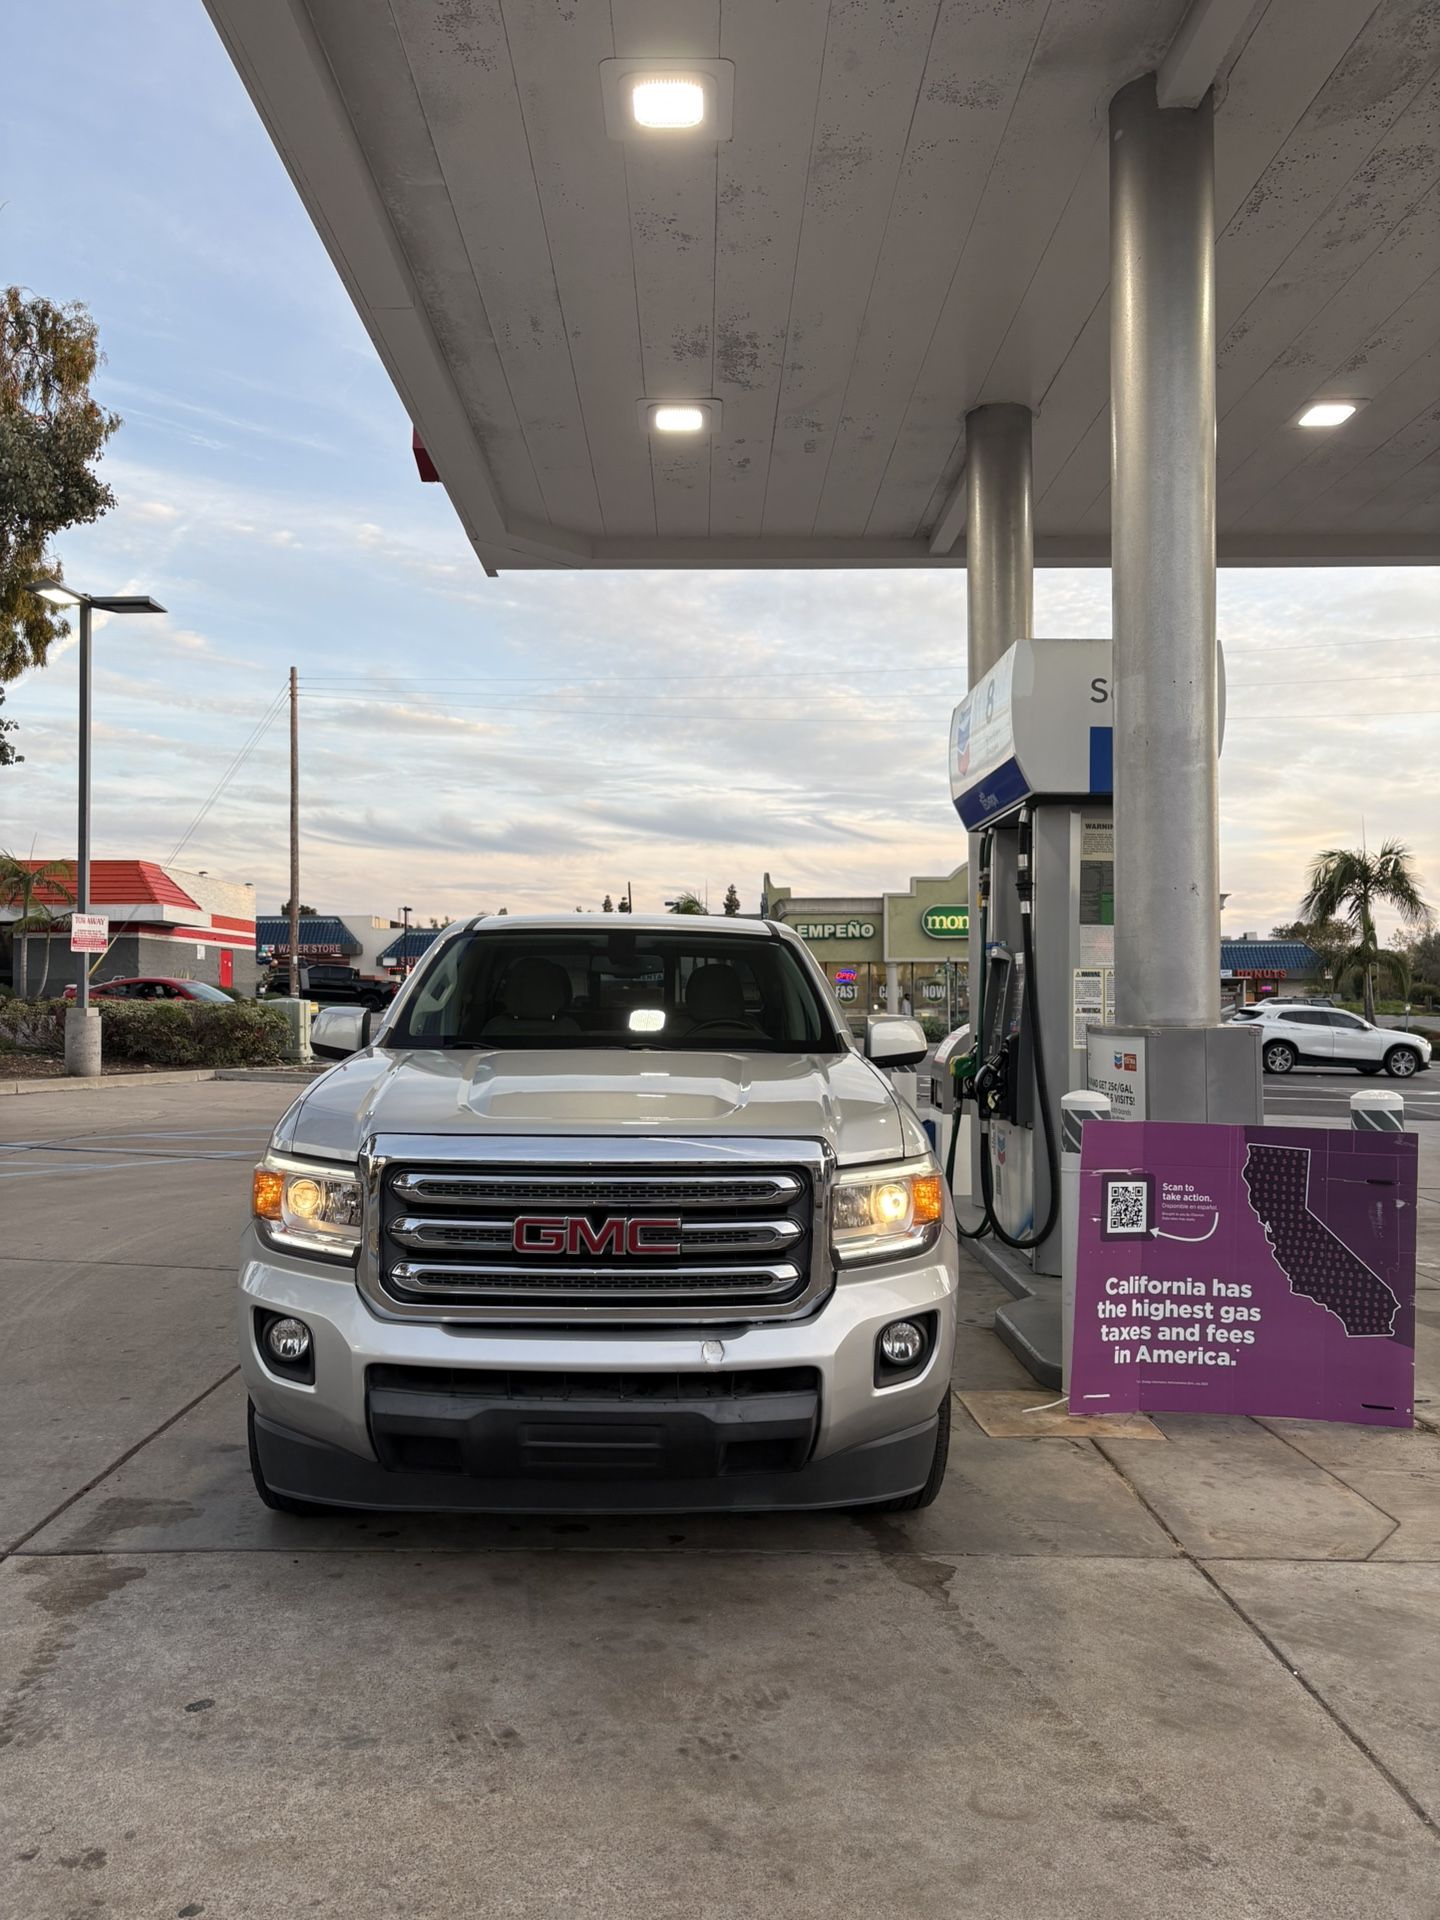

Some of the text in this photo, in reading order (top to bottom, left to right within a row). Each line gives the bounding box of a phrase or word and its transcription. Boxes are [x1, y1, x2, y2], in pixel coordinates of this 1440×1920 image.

[986, 679, 995, 723] 8
[87, 917, 106, 926] AWAY
[796, 921, 874, 938] EMPEÑO
[311, 944, 341, 954] STORE
[834, 971, 858, 981] OPEN
[1236, 969, 1287, 979] DONUTS
[834, 985, 859, 998] FAST
[922, 985, 947, 998] NOW
[1162, 1182, 1195, 1192] Scan to
[1162, 1192, 1212, 1202] take action.
[514, 1216, 681, 1255] GMC
[1105, 1276, 1252, 1298] California has
[1097, 1299, 1261, 1323] the highest gas
[1101, 1324, 1255, 1344] taxes and fees
[1114, 1346, 1130, 1364] in
